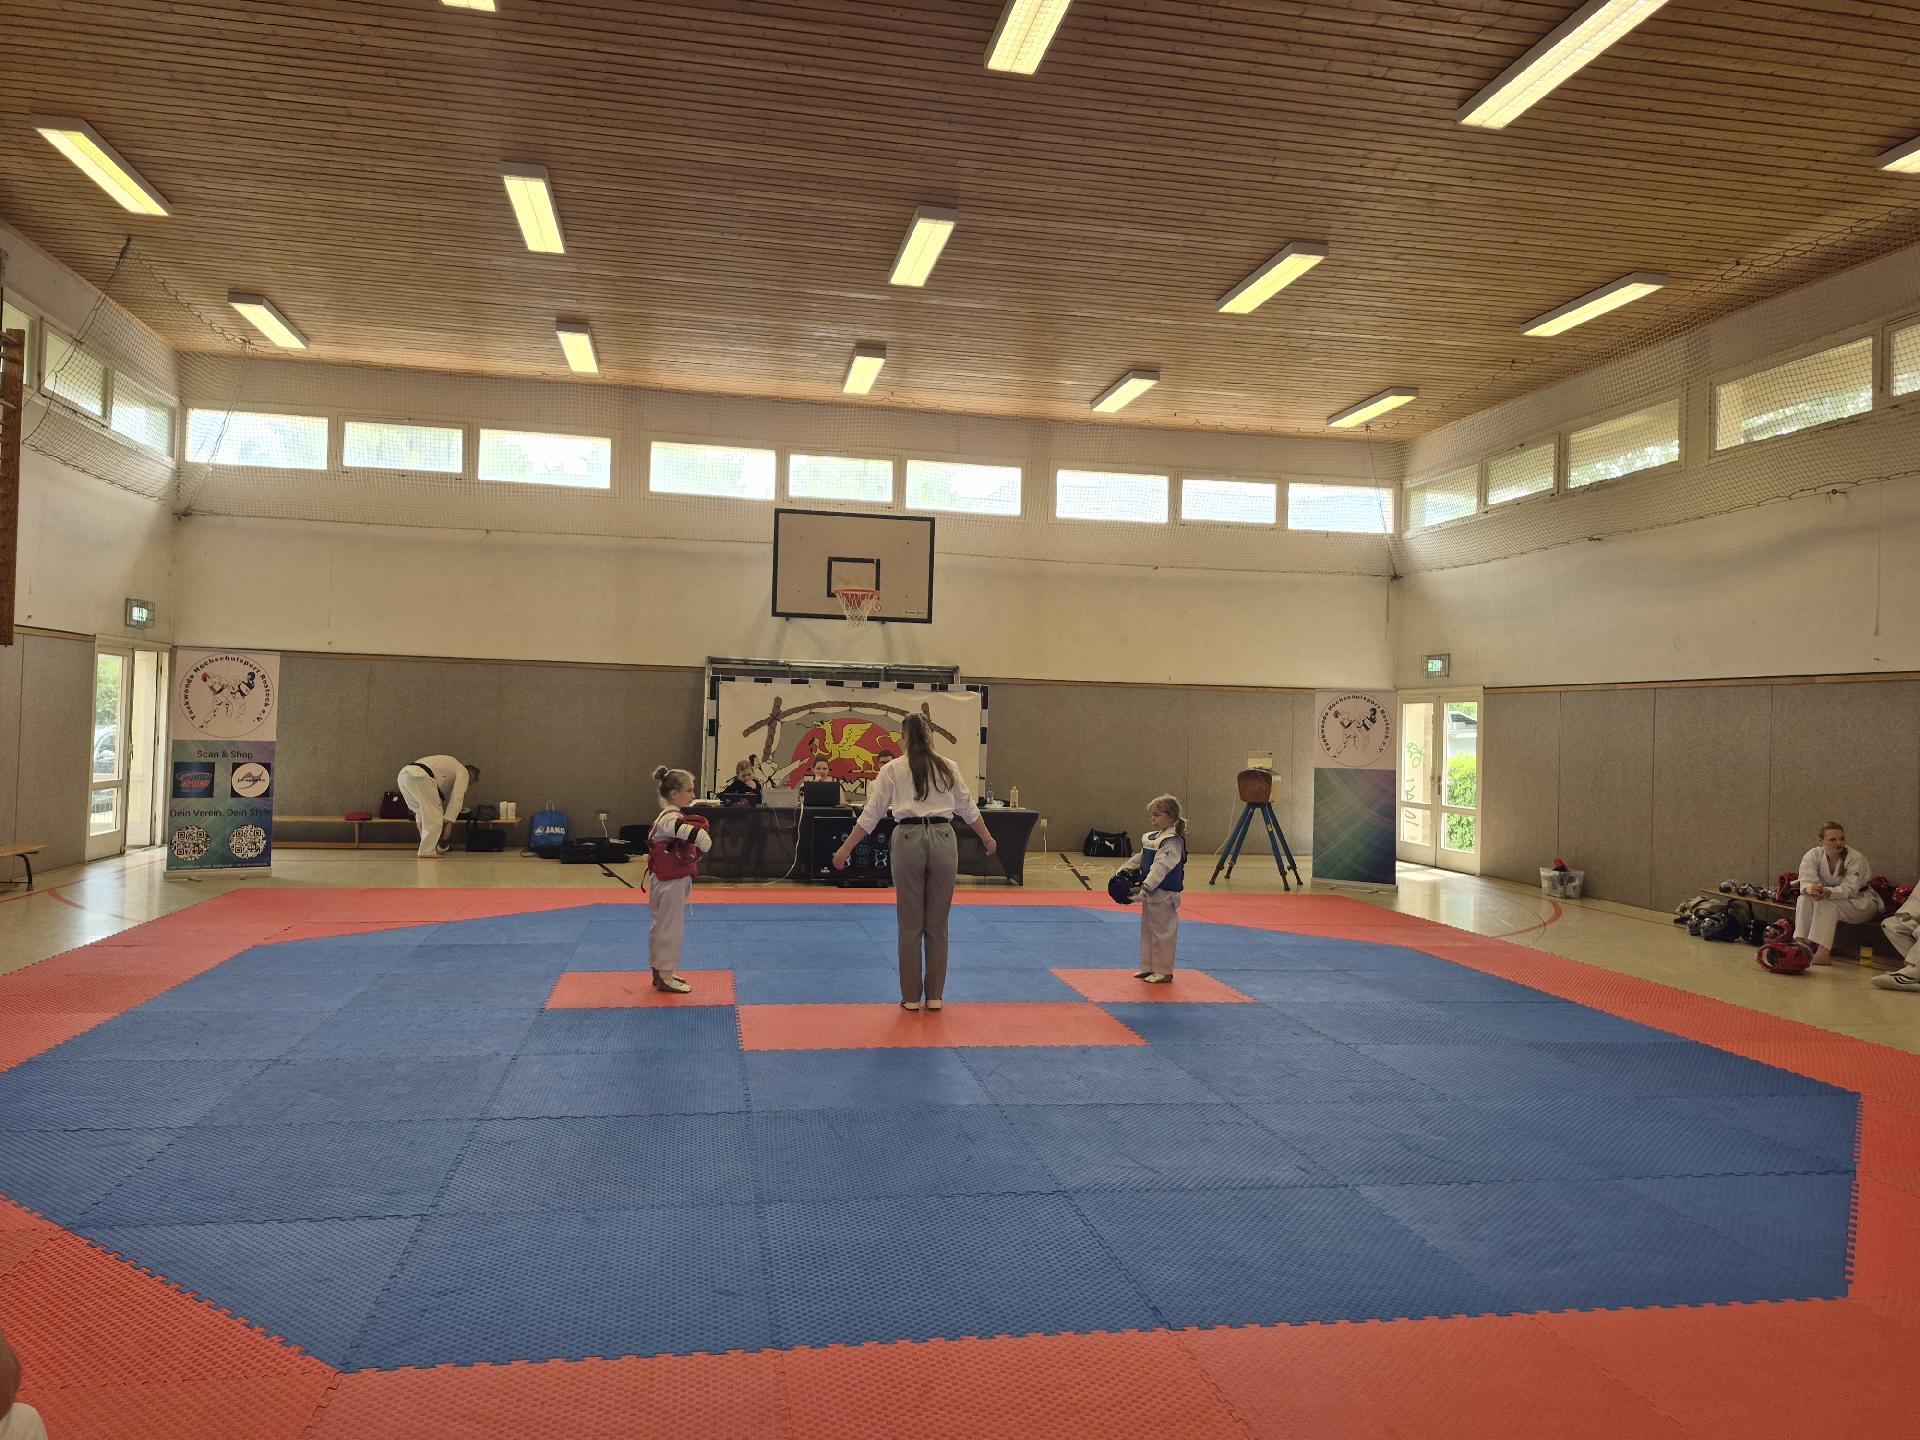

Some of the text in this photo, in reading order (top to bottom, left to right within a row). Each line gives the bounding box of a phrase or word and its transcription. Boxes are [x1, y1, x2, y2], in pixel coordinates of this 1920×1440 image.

[183, 674, 196, 720] Taekwondo
[193, 655, 260, 673] Hochschulsport
[260, 673, 270, 707] Rostock
[1321, 711, 1331, 751] Taekwondo
[1327, 694, 1381, 711] Hochschulsport
[1380, 709, 1390, 739] Rostock
[196, 750, 253, 760] Scan & Shop
[169, 809, 191, 817] Dein
[227, 808, 246, 816] Dein
